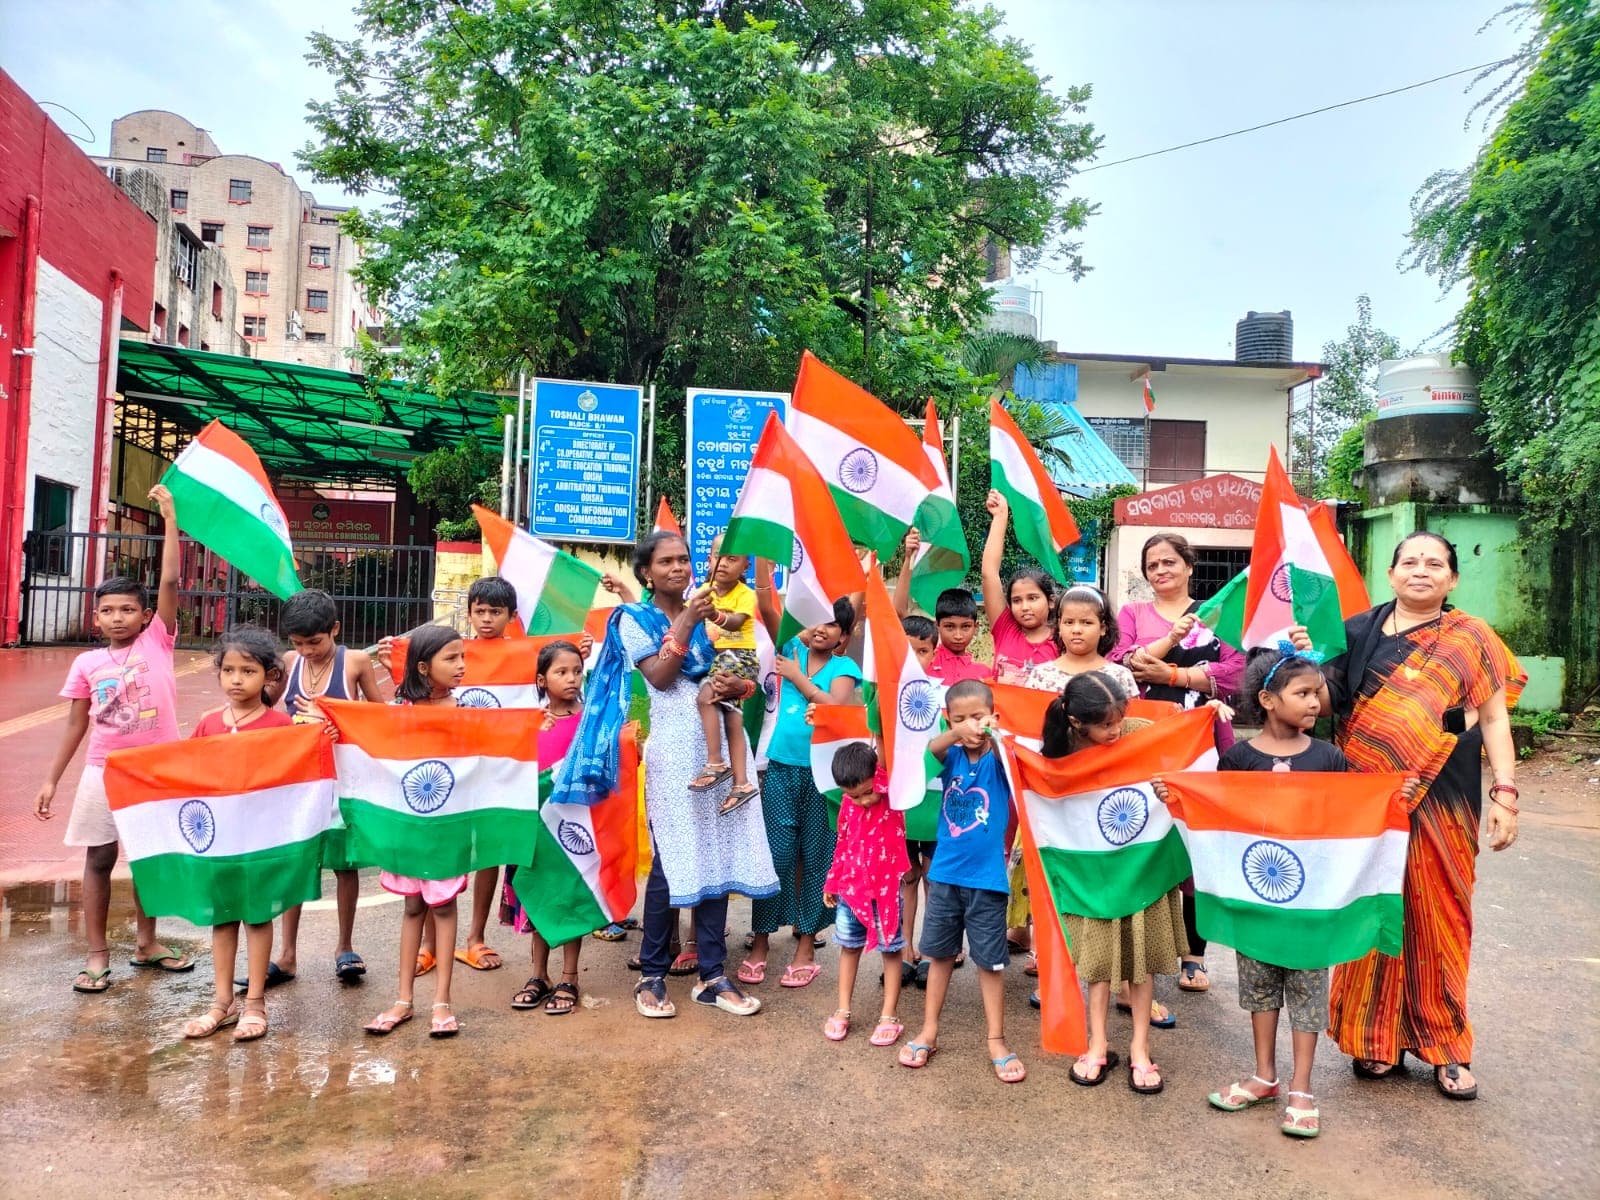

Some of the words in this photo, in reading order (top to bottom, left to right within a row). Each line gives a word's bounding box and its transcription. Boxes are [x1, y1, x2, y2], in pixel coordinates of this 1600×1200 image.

[550, 410, 586, 421] TOSHALI
[587, 413, 625, 423] BHAWAN
[572, 439, 608, 451] DIRECTORATE
[608, 442, 616, 452] OF
[594, 451, 610, 460] AUDIT
[556, 460, 572, 470] STATE
[573, 461, 603, 472] EDUCATION
[583, 471, 603, 481] ODISHA
[555, 481, 596, 493] ARBITRATION
[580, 493, 604, 503] ODISHA
[554, 503, 580, 514] ODISHA
[581, 505, 628, 517] INFORMATION
[568, 514, 613, 526] COMMISSION
[334, 531, 380, 541] COMMISSION
